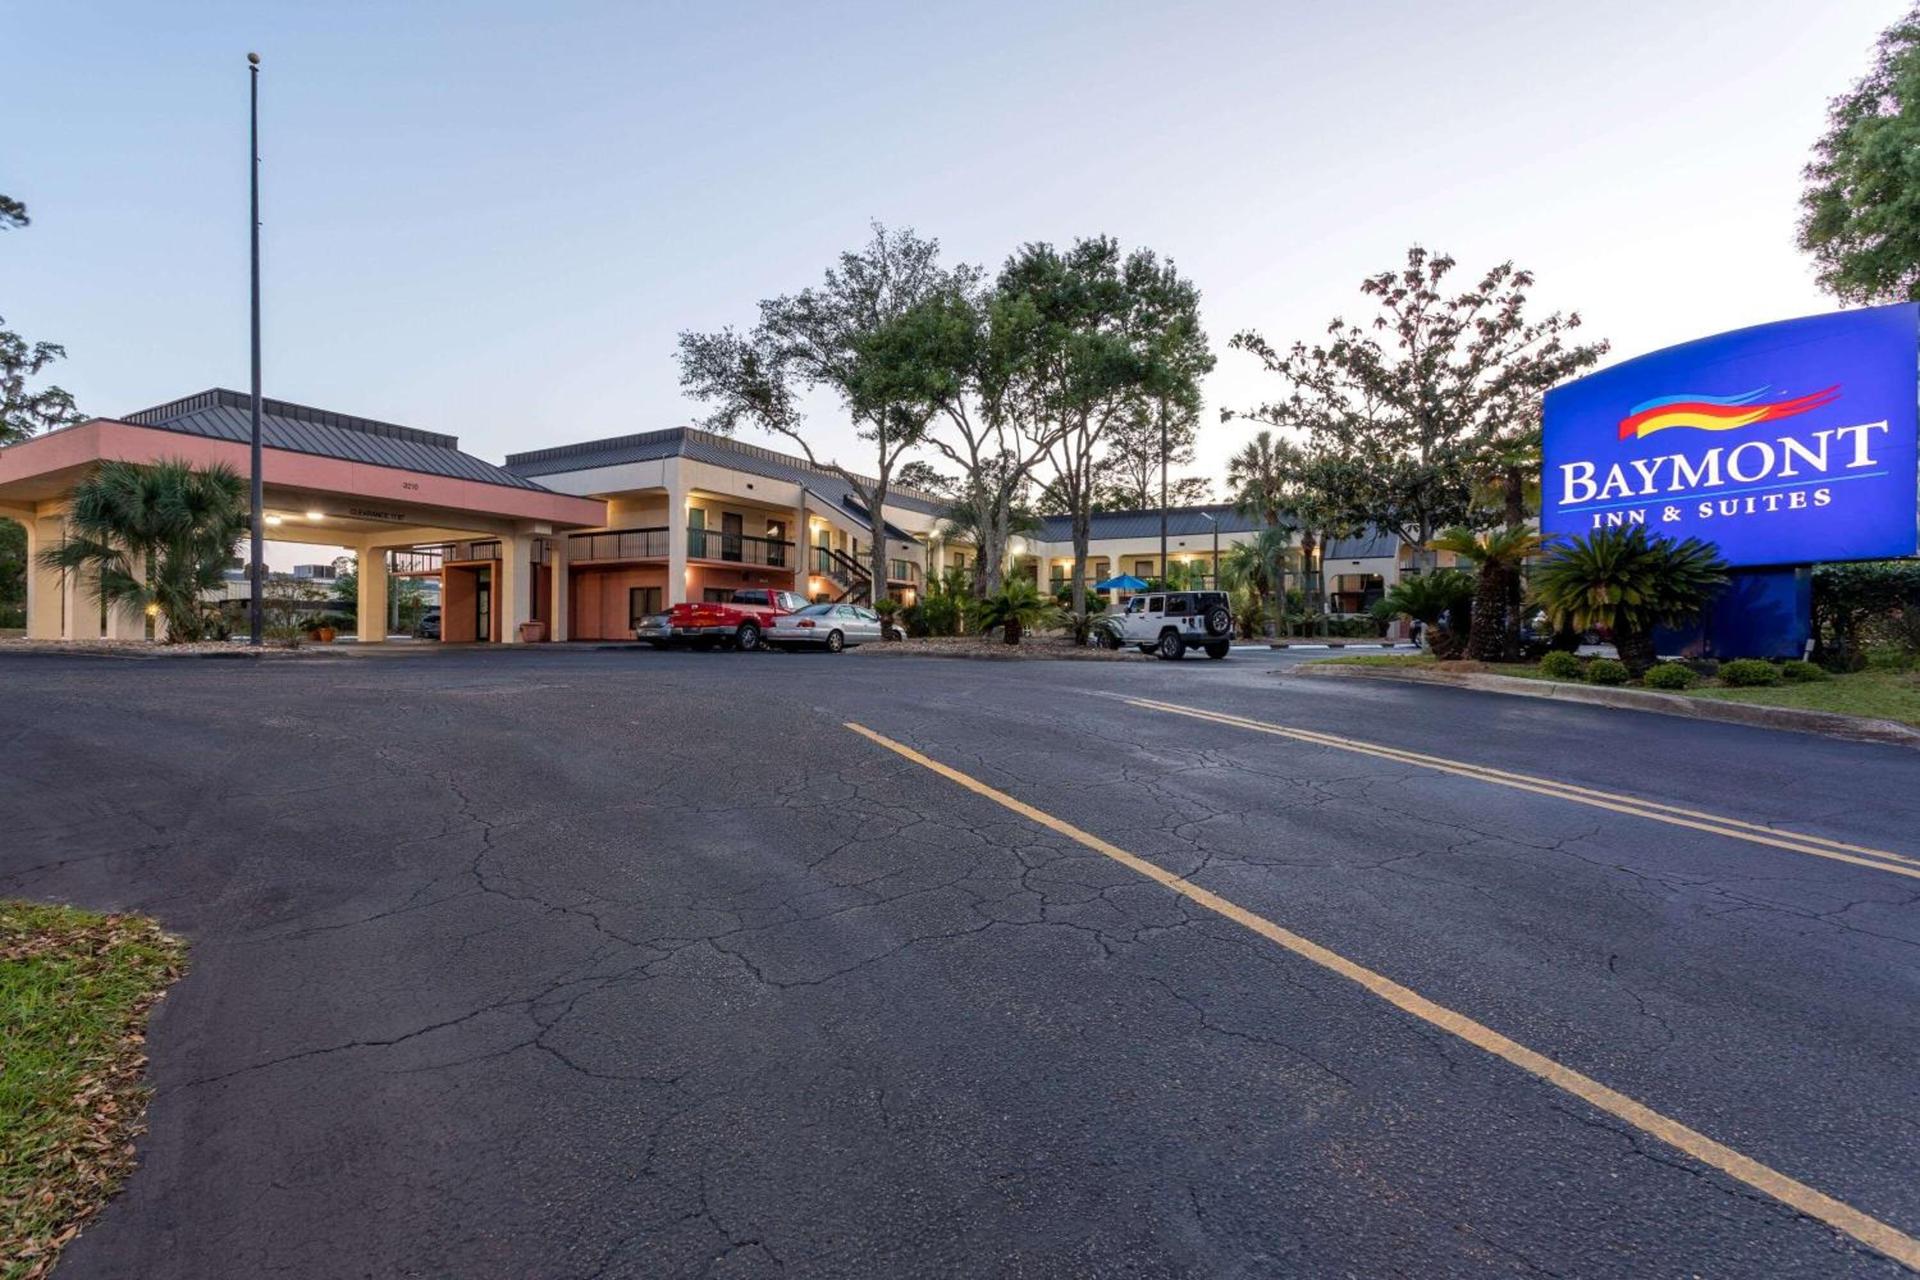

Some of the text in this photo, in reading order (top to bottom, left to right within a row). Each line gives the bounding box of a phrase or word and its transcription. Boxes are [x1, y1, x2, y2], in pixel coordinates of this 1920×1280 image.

[1557, 418, 1890, 506] BAYMONT
[1592, 487, 1832, 529] INN & SUITES
